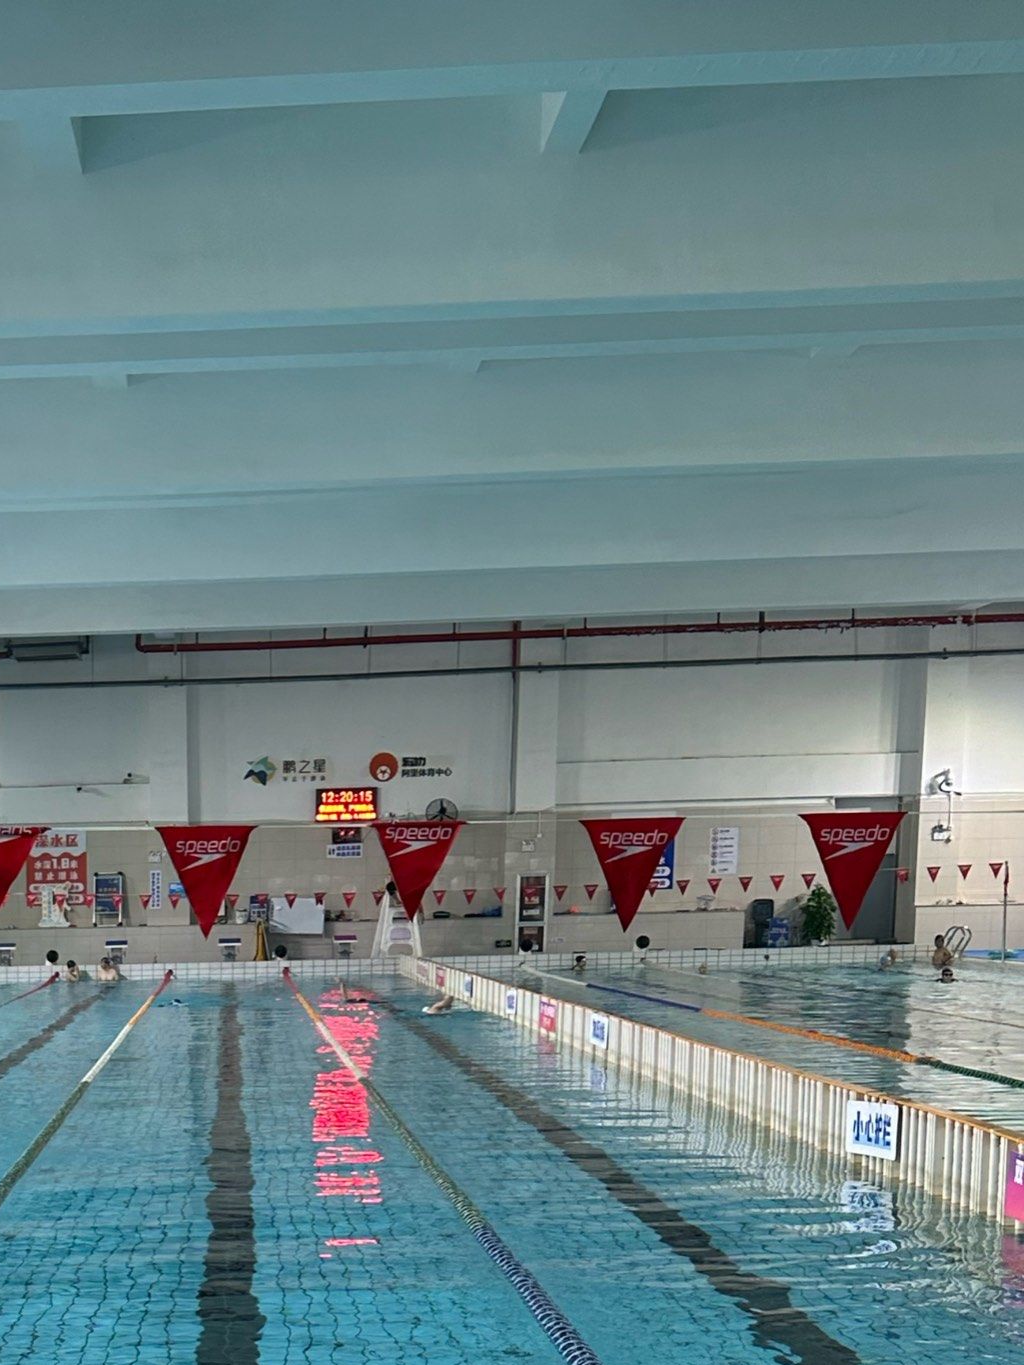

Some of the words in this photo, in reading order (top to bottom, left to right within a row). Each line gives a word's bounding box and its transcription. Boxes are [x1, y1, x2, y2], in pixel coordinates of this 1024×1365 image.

[283, 759, 326, 773] 鹏之星
[401, 767, 453, 777] 阿里体育中心
[321, 790, 373, 803] 12:20:15
[385, 825, 453, 842] speedo
[599, 829, 669, 847] speedo
[820, 824, 891, 842] speedo
[176, 836, 241, 854] speedo
